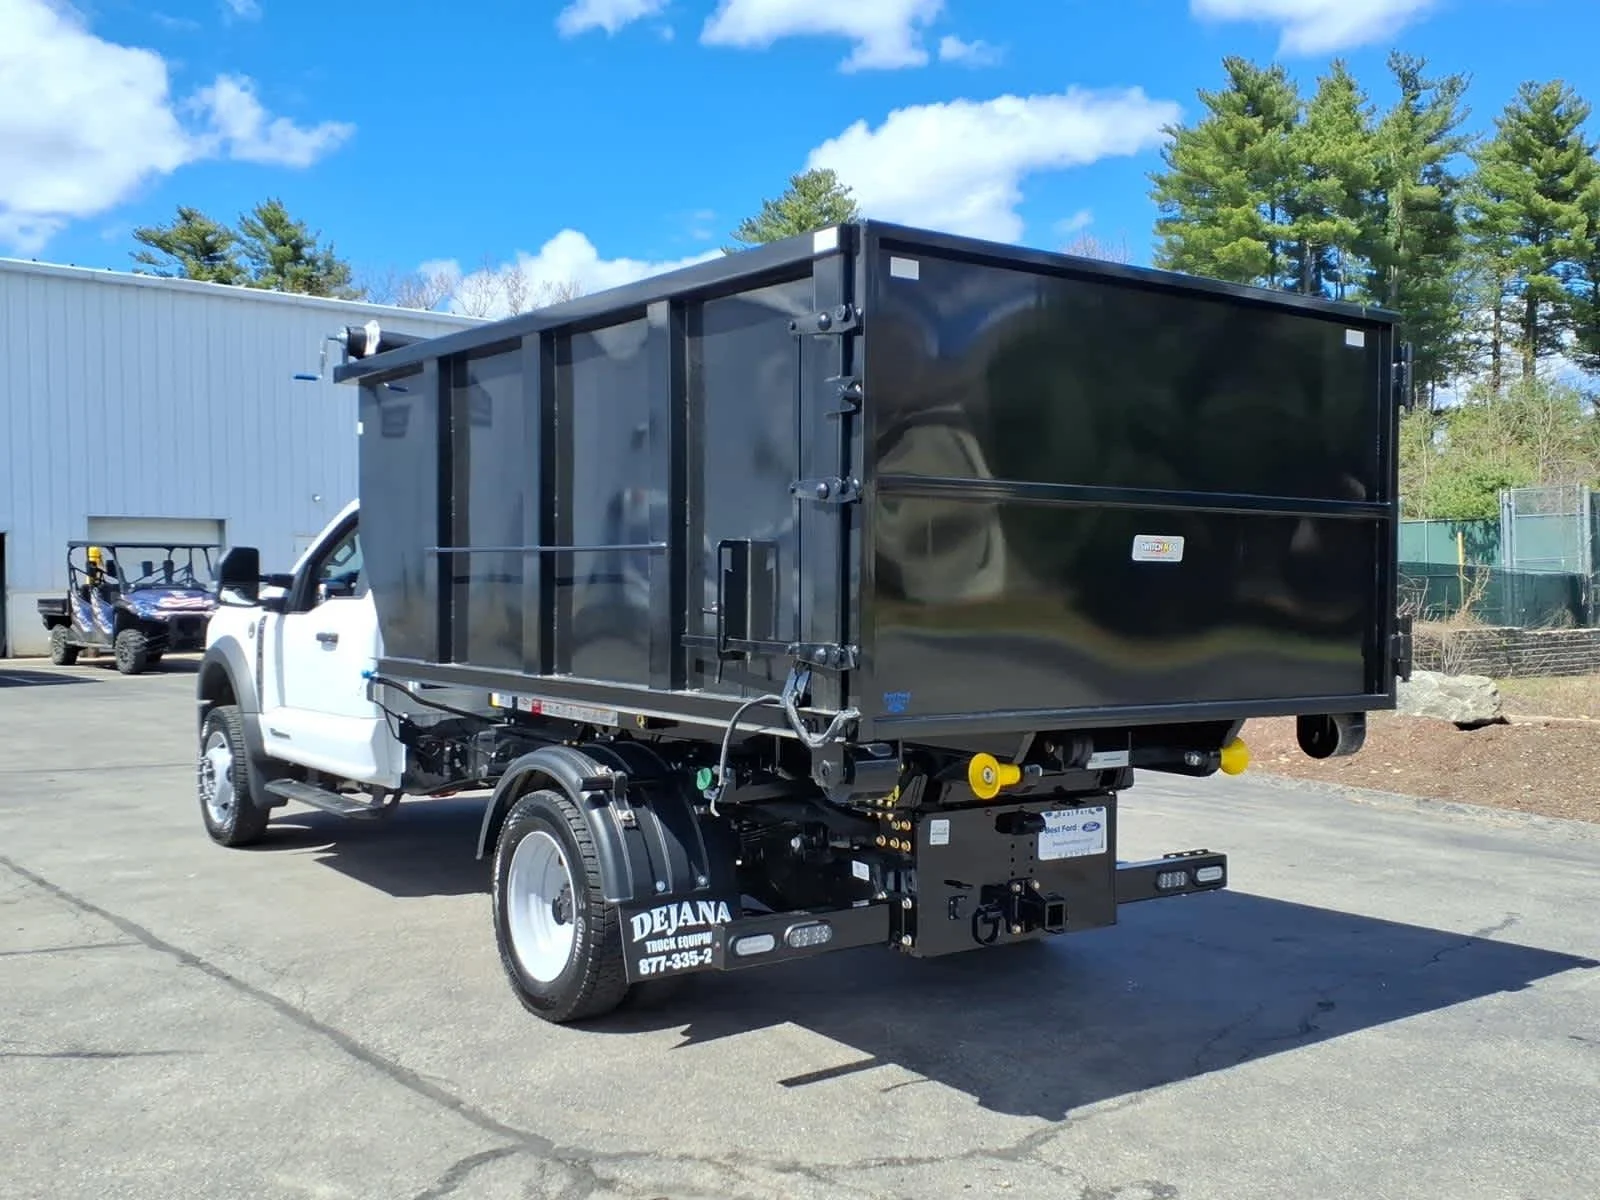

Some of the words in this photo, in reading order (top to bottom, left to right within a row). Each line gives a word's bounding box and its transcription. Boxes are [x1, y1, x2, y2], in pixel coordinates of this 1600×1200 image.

[1061, 824, 1077, 832] Ford
[630, 901, 732, 942] DEJANA
[645, 938, 677, 953] TRUCK
[639, 948, 713, 975] 877-335-2
